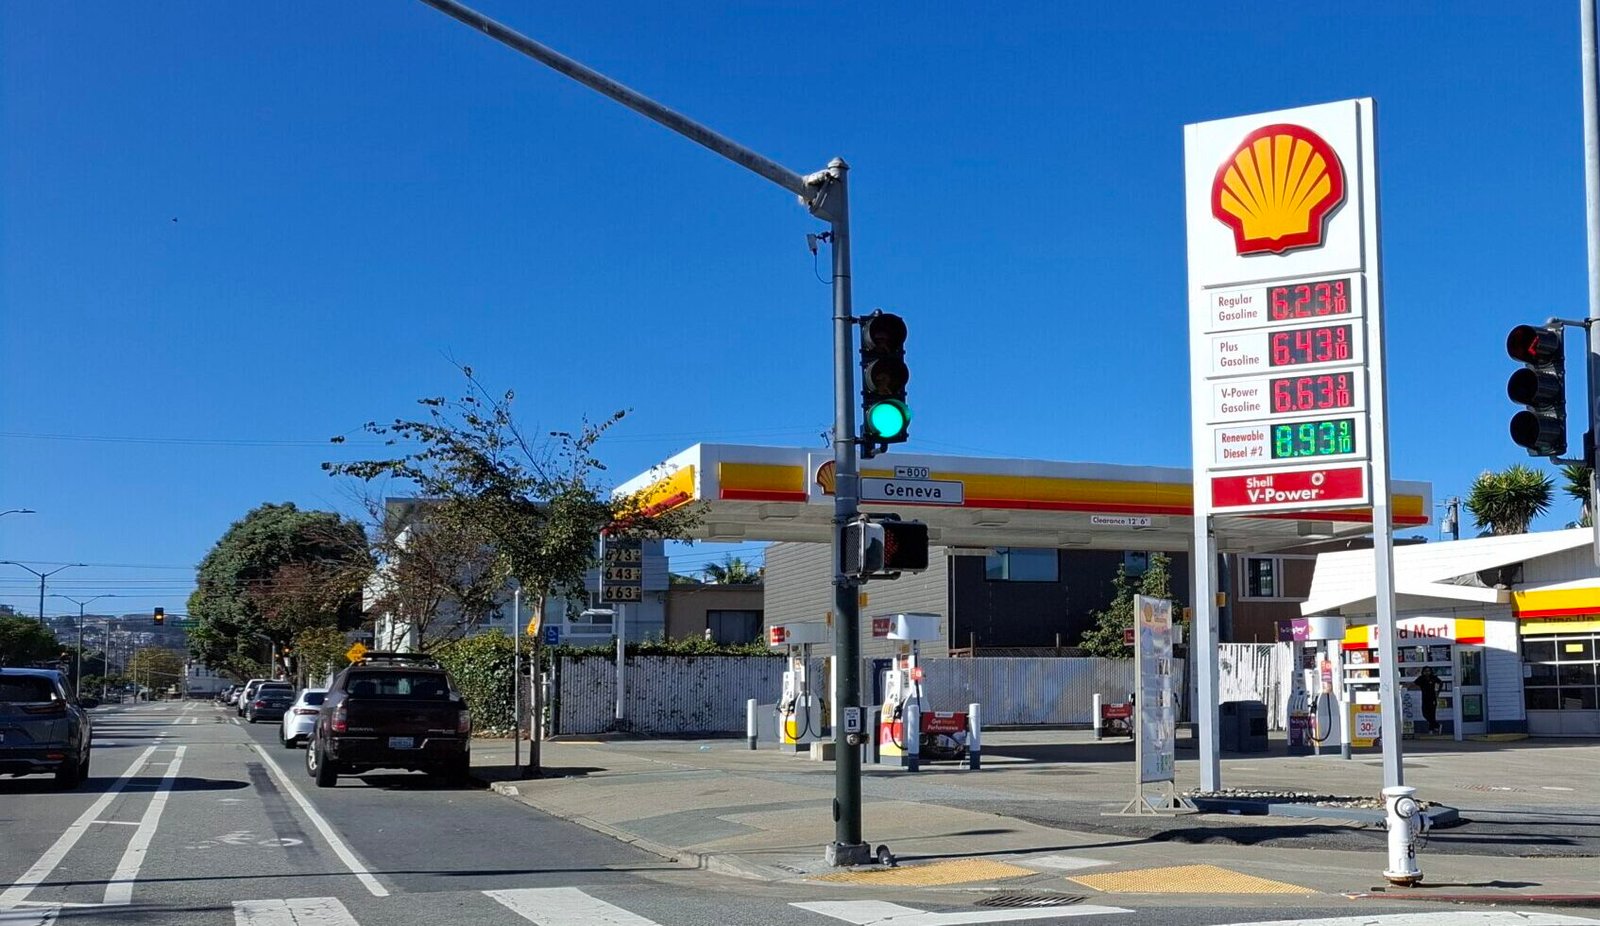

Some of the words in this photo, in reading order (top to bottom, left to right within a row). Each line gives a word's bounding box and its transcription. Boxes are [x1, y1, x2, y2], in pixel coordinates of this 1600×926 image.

[1218, 293, 1252, 308] Regular
[1272, 282, 1331, 320] 6.23
[1218, 308, 1258, 321] Gasoline
[1220, 341, 1239, 352] Plus
[1273, 328, 1332, 365] 6.43
[1220, 354, 1260, 367] Gasoline
[1221, 387, 1258, 399] V-Power
[1274, 375, 1334, 412] 6.63
[1221, 401, 1261, 414] Gasoline
[1221, 430, 1265, 443] Renewable
[1276, 421, 1335, 457] 8.93
[1223, 446, 1248, 459] Diesel
[1250, 446, 1263, 456] #2
[906, 467, 928, 477] 800
[1246, 475, 1273, 488] Shell
[884, 482, 942, 498] Geneva
[1247, 486, 1319, 502] V-Power
[1092, 516, 1126, 524] Clearance
[605, 568, 632, 580] 643
[605, 587, 632, 599] 663
[1413, 624, 1448, 638] Mart
